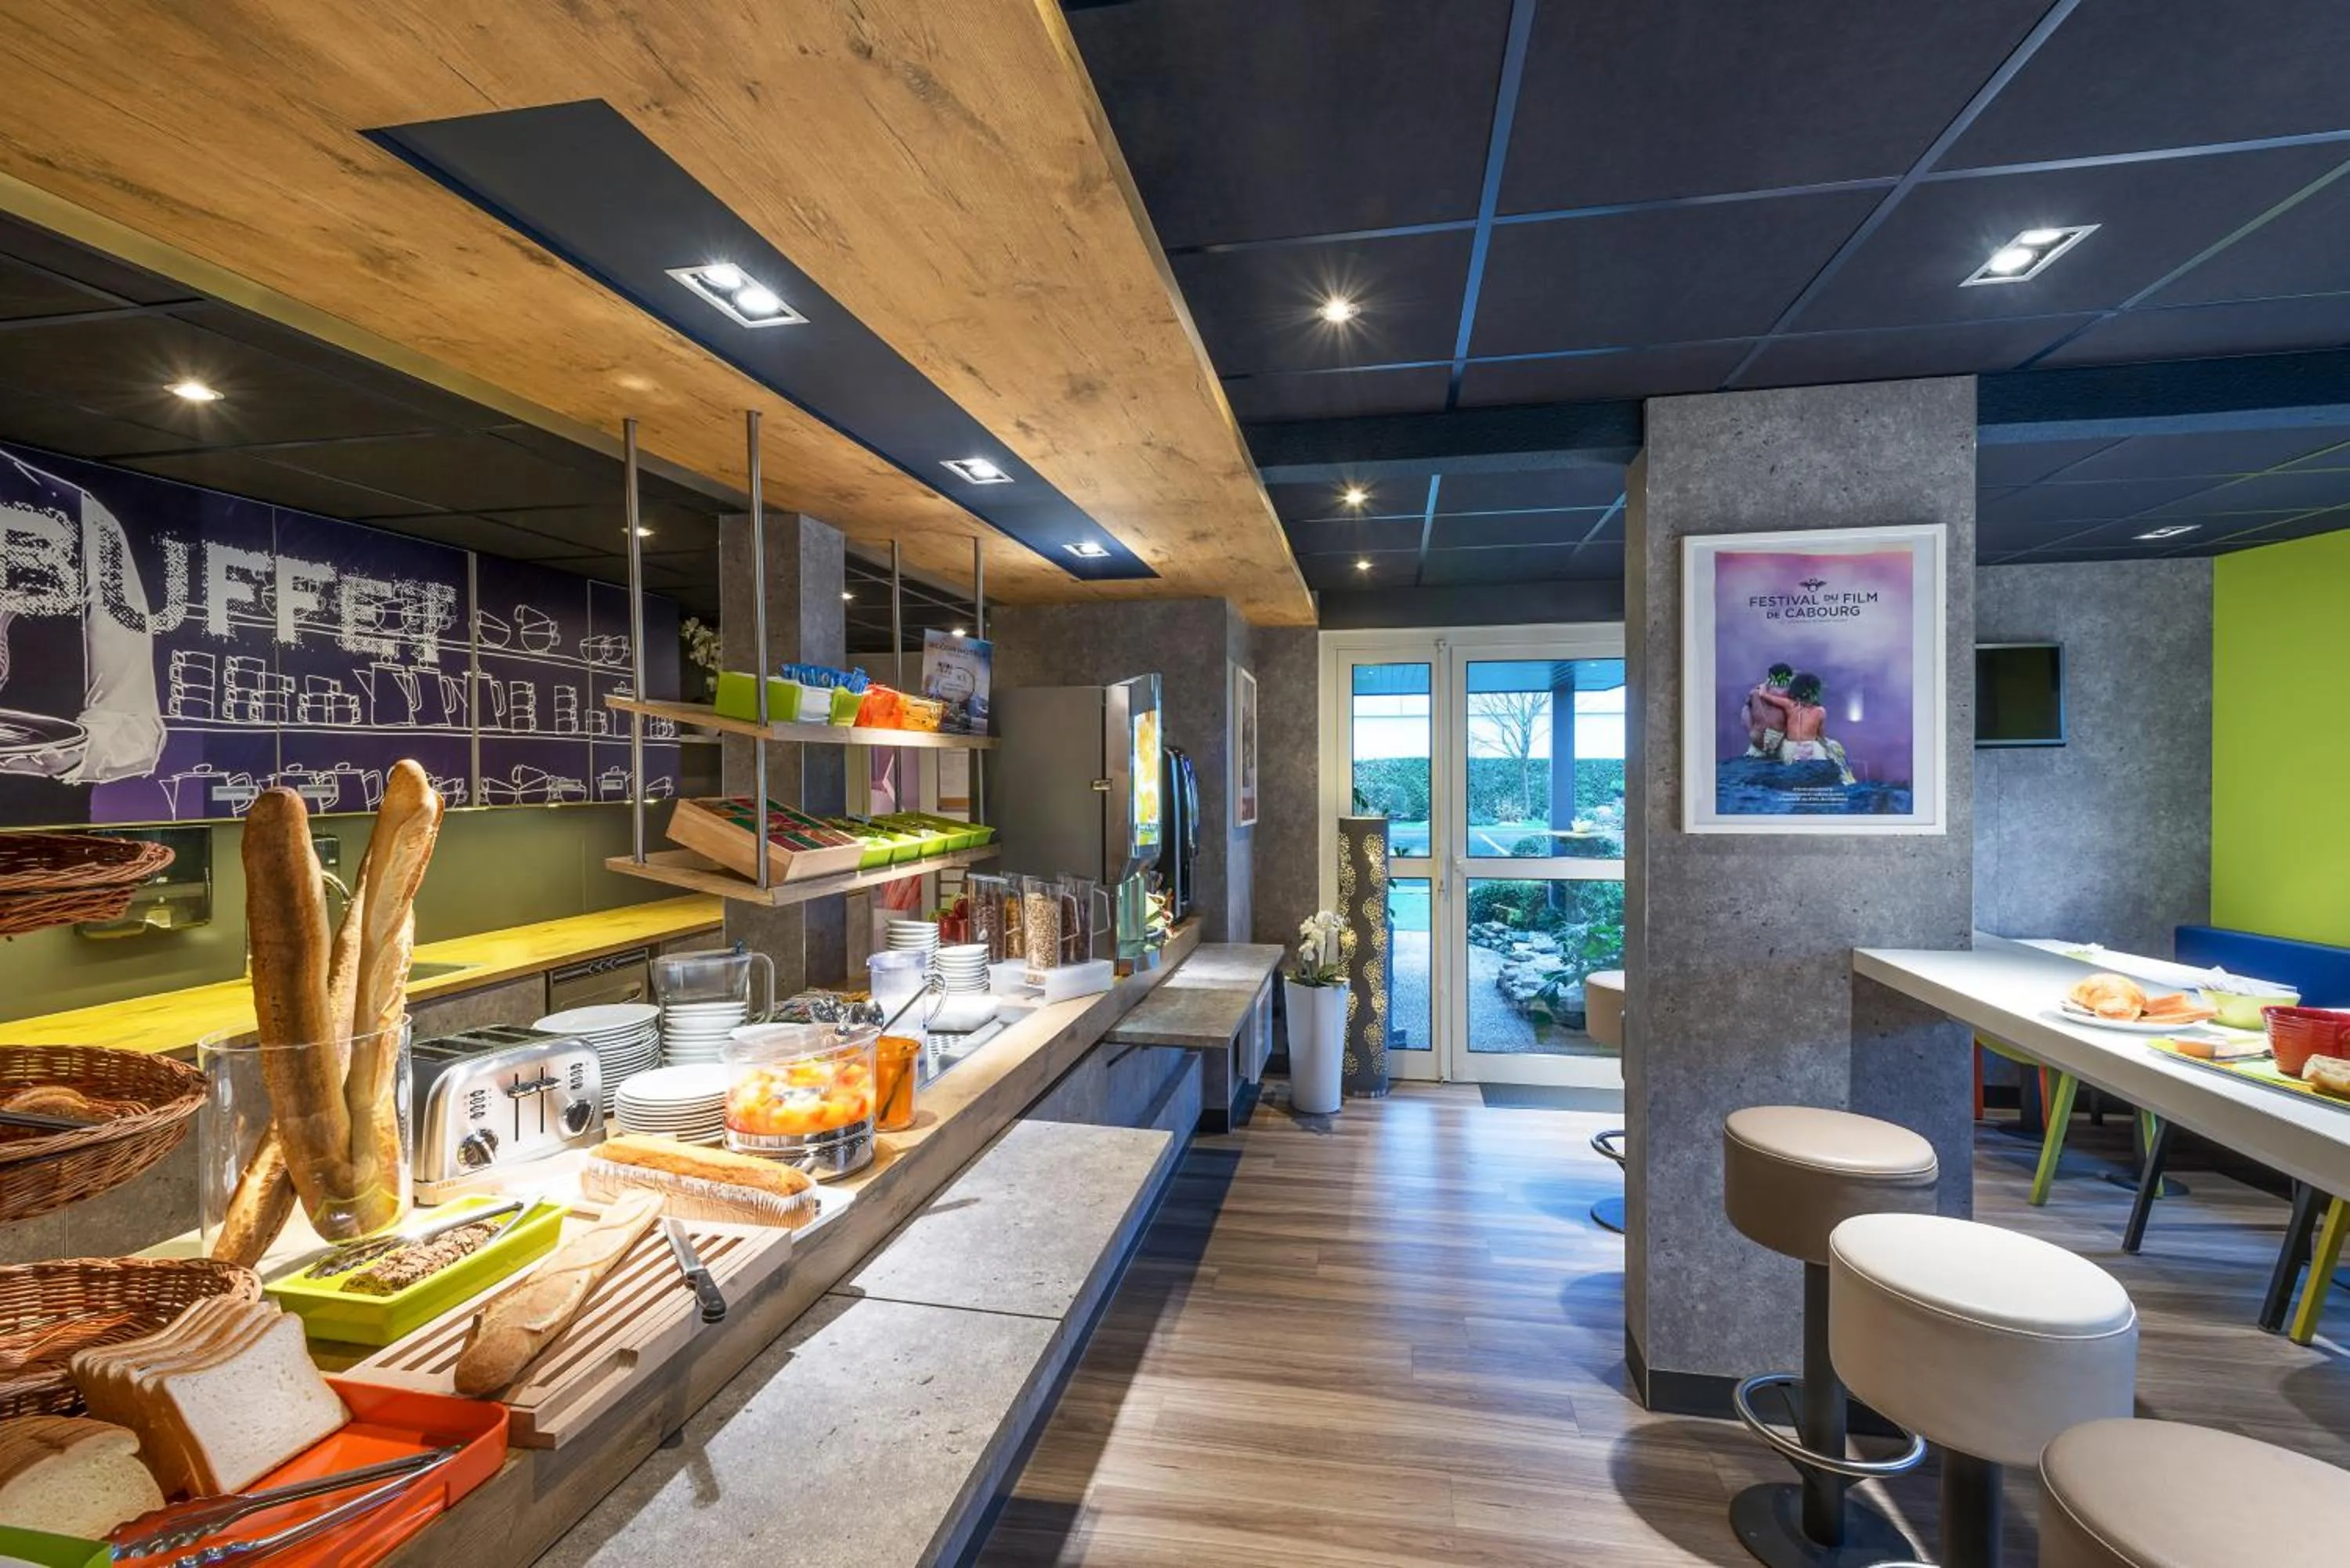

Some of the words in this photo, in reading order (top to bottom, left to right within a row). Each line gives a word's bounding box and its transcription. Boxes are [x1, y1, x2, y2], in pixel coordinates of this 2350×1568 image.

[0, 500, 457, 662] BUFFET
[1749, 595, 1818, 607] FESTIVAL
[1824, 594, 1838, 602] DU
[1843, 592, 1878, 603] FILM
[1785, 606, 1860, 618] CABOURG
